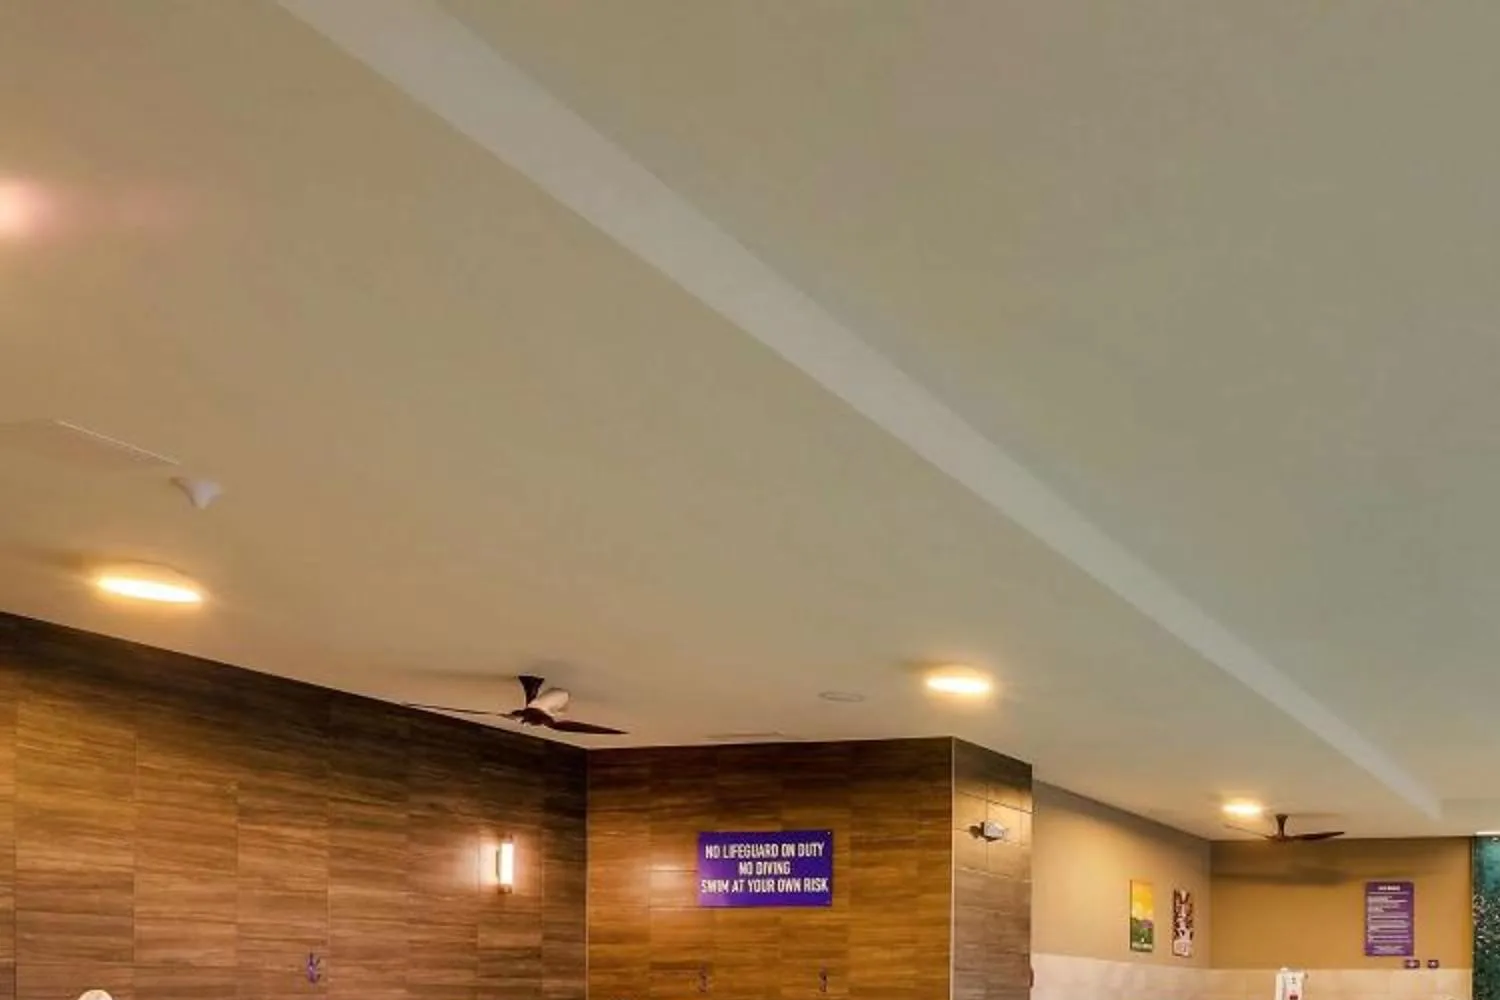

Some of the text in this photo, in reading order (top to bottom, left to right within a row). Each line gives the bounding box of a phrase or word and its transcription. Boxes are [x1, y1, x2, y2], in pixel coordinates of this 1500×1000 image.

[705, 841, 825, 859] NO LIFEGUARD ON DUTY
[739, 861, 791, 876] NO DIVING
[701, 877, 829, 893] SWIM AT YOUR OWN RISK
